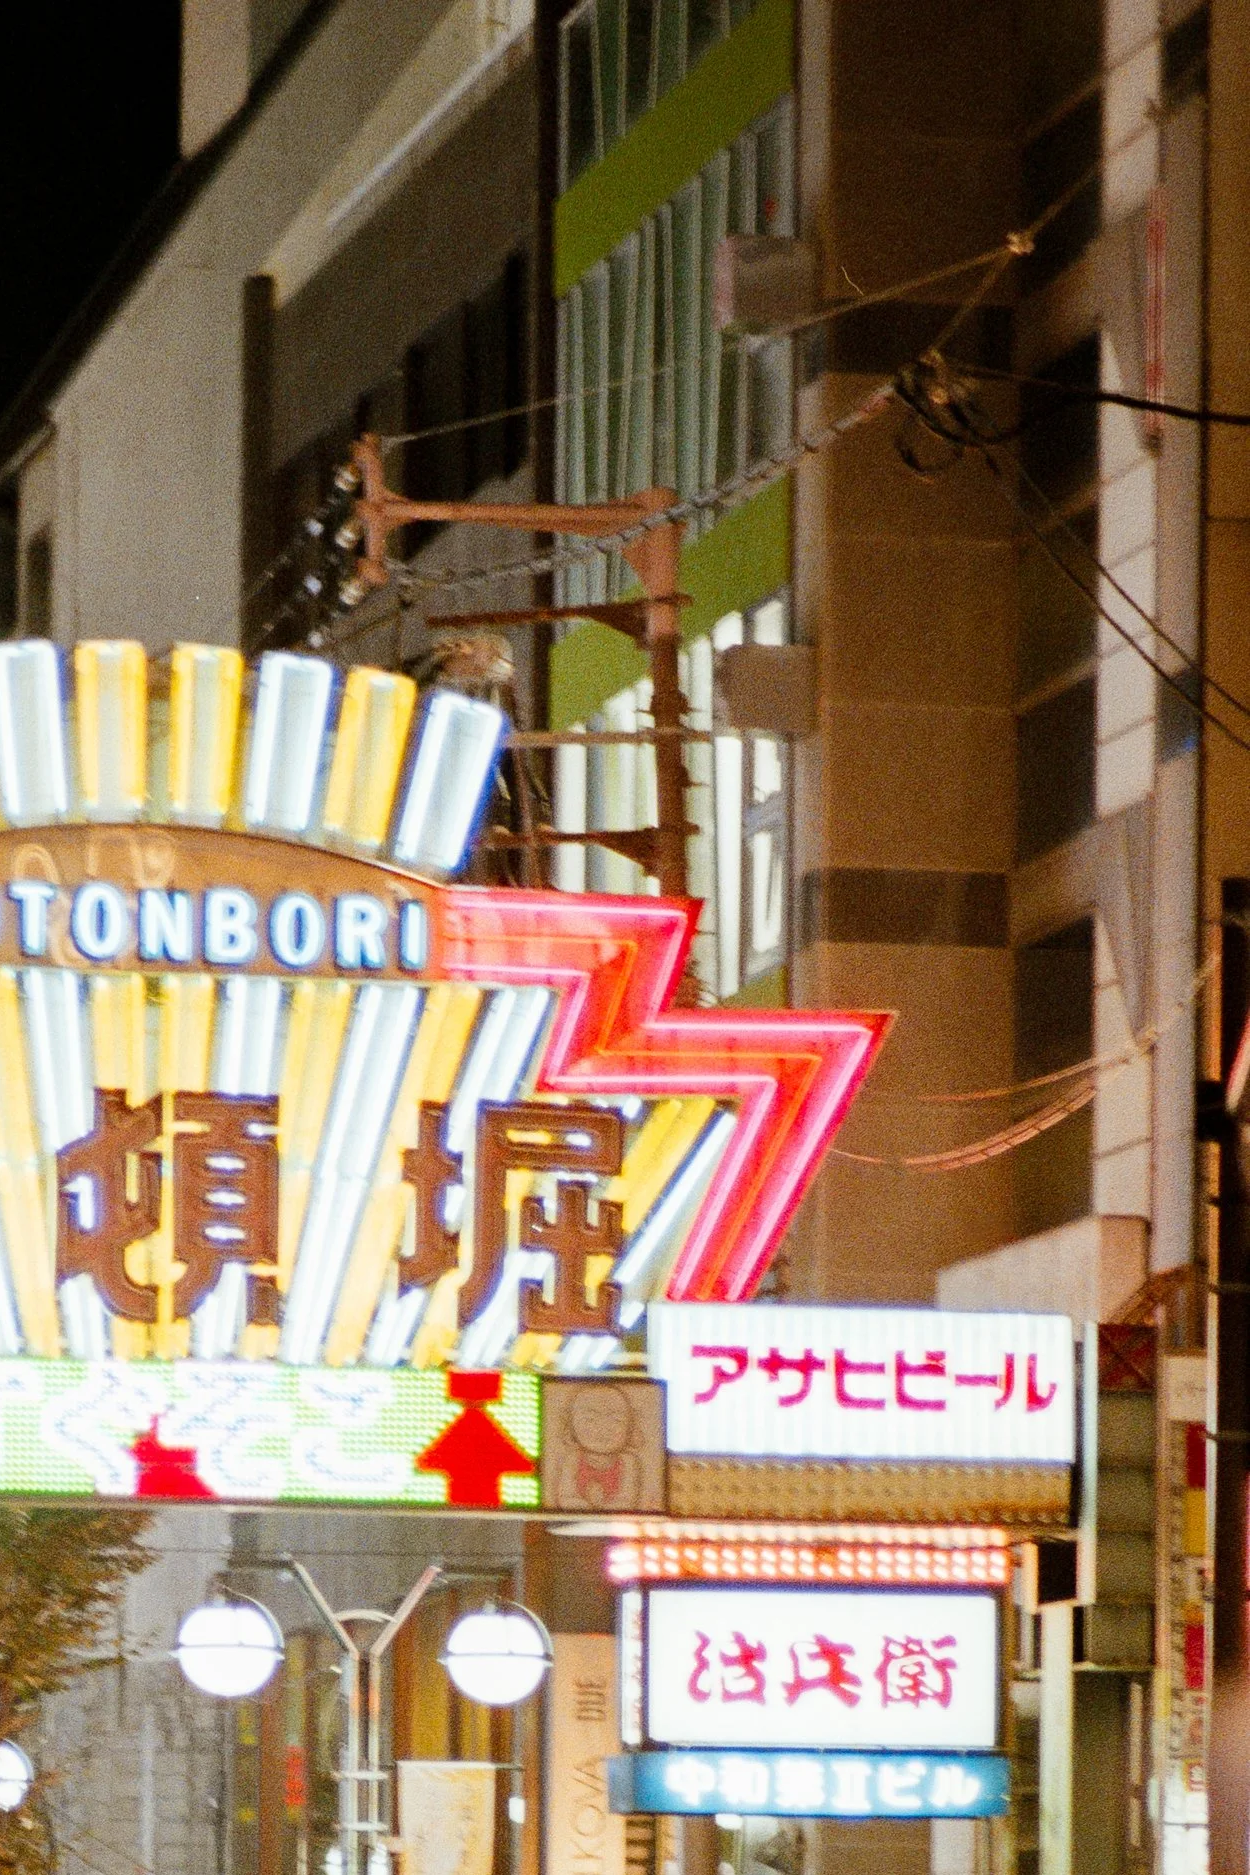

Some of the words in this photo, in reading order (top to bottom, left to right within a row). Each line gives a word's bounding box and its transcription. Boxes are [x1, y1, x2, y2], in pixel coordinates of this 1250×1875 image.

[691, 1343, 1058, 1412] アサヒビール
